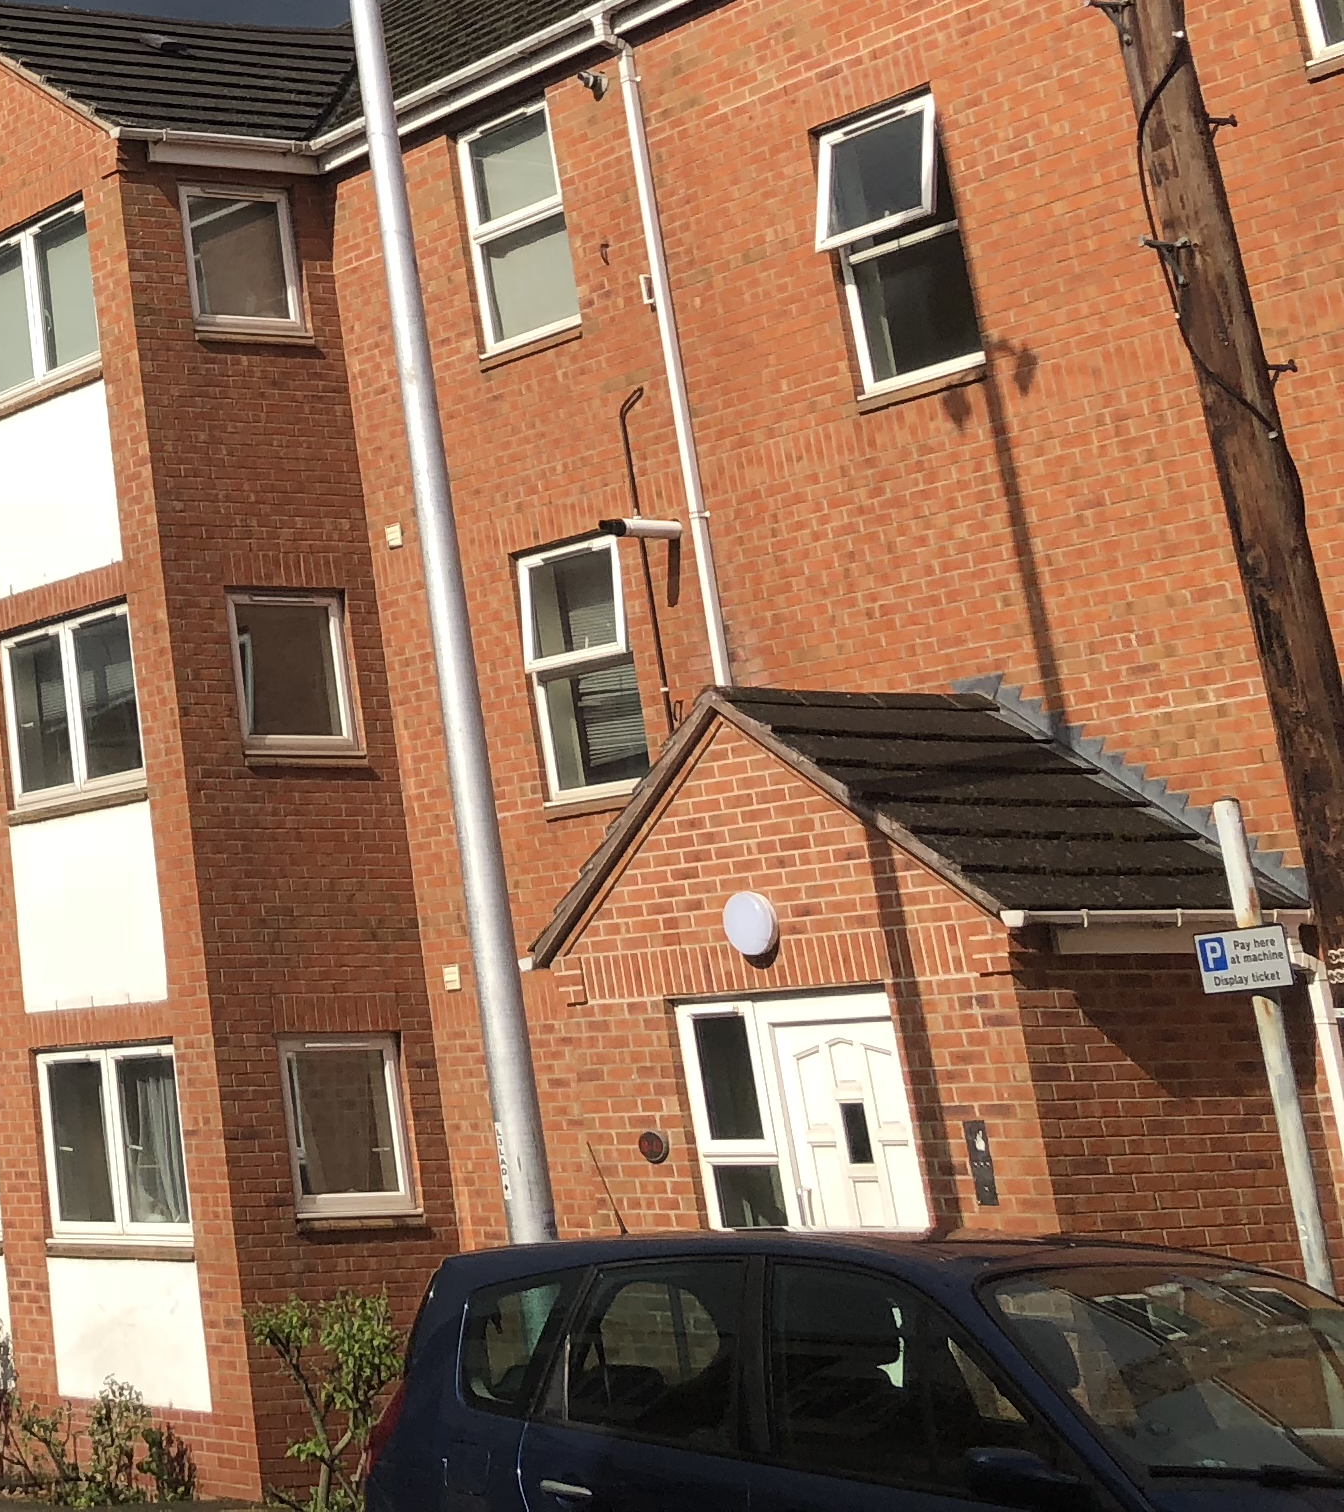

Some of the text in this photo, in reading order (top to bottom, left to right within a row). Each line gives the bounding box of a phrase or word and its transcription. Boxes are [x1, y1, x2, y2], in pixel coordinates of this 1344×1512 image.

[1233, 938, 1276, 951] Pay here
[1205, 942, 1222, 969] P
[1230, 950, 1284, 964] at machine
[1214, 971, 1281, 987] Display ticket
